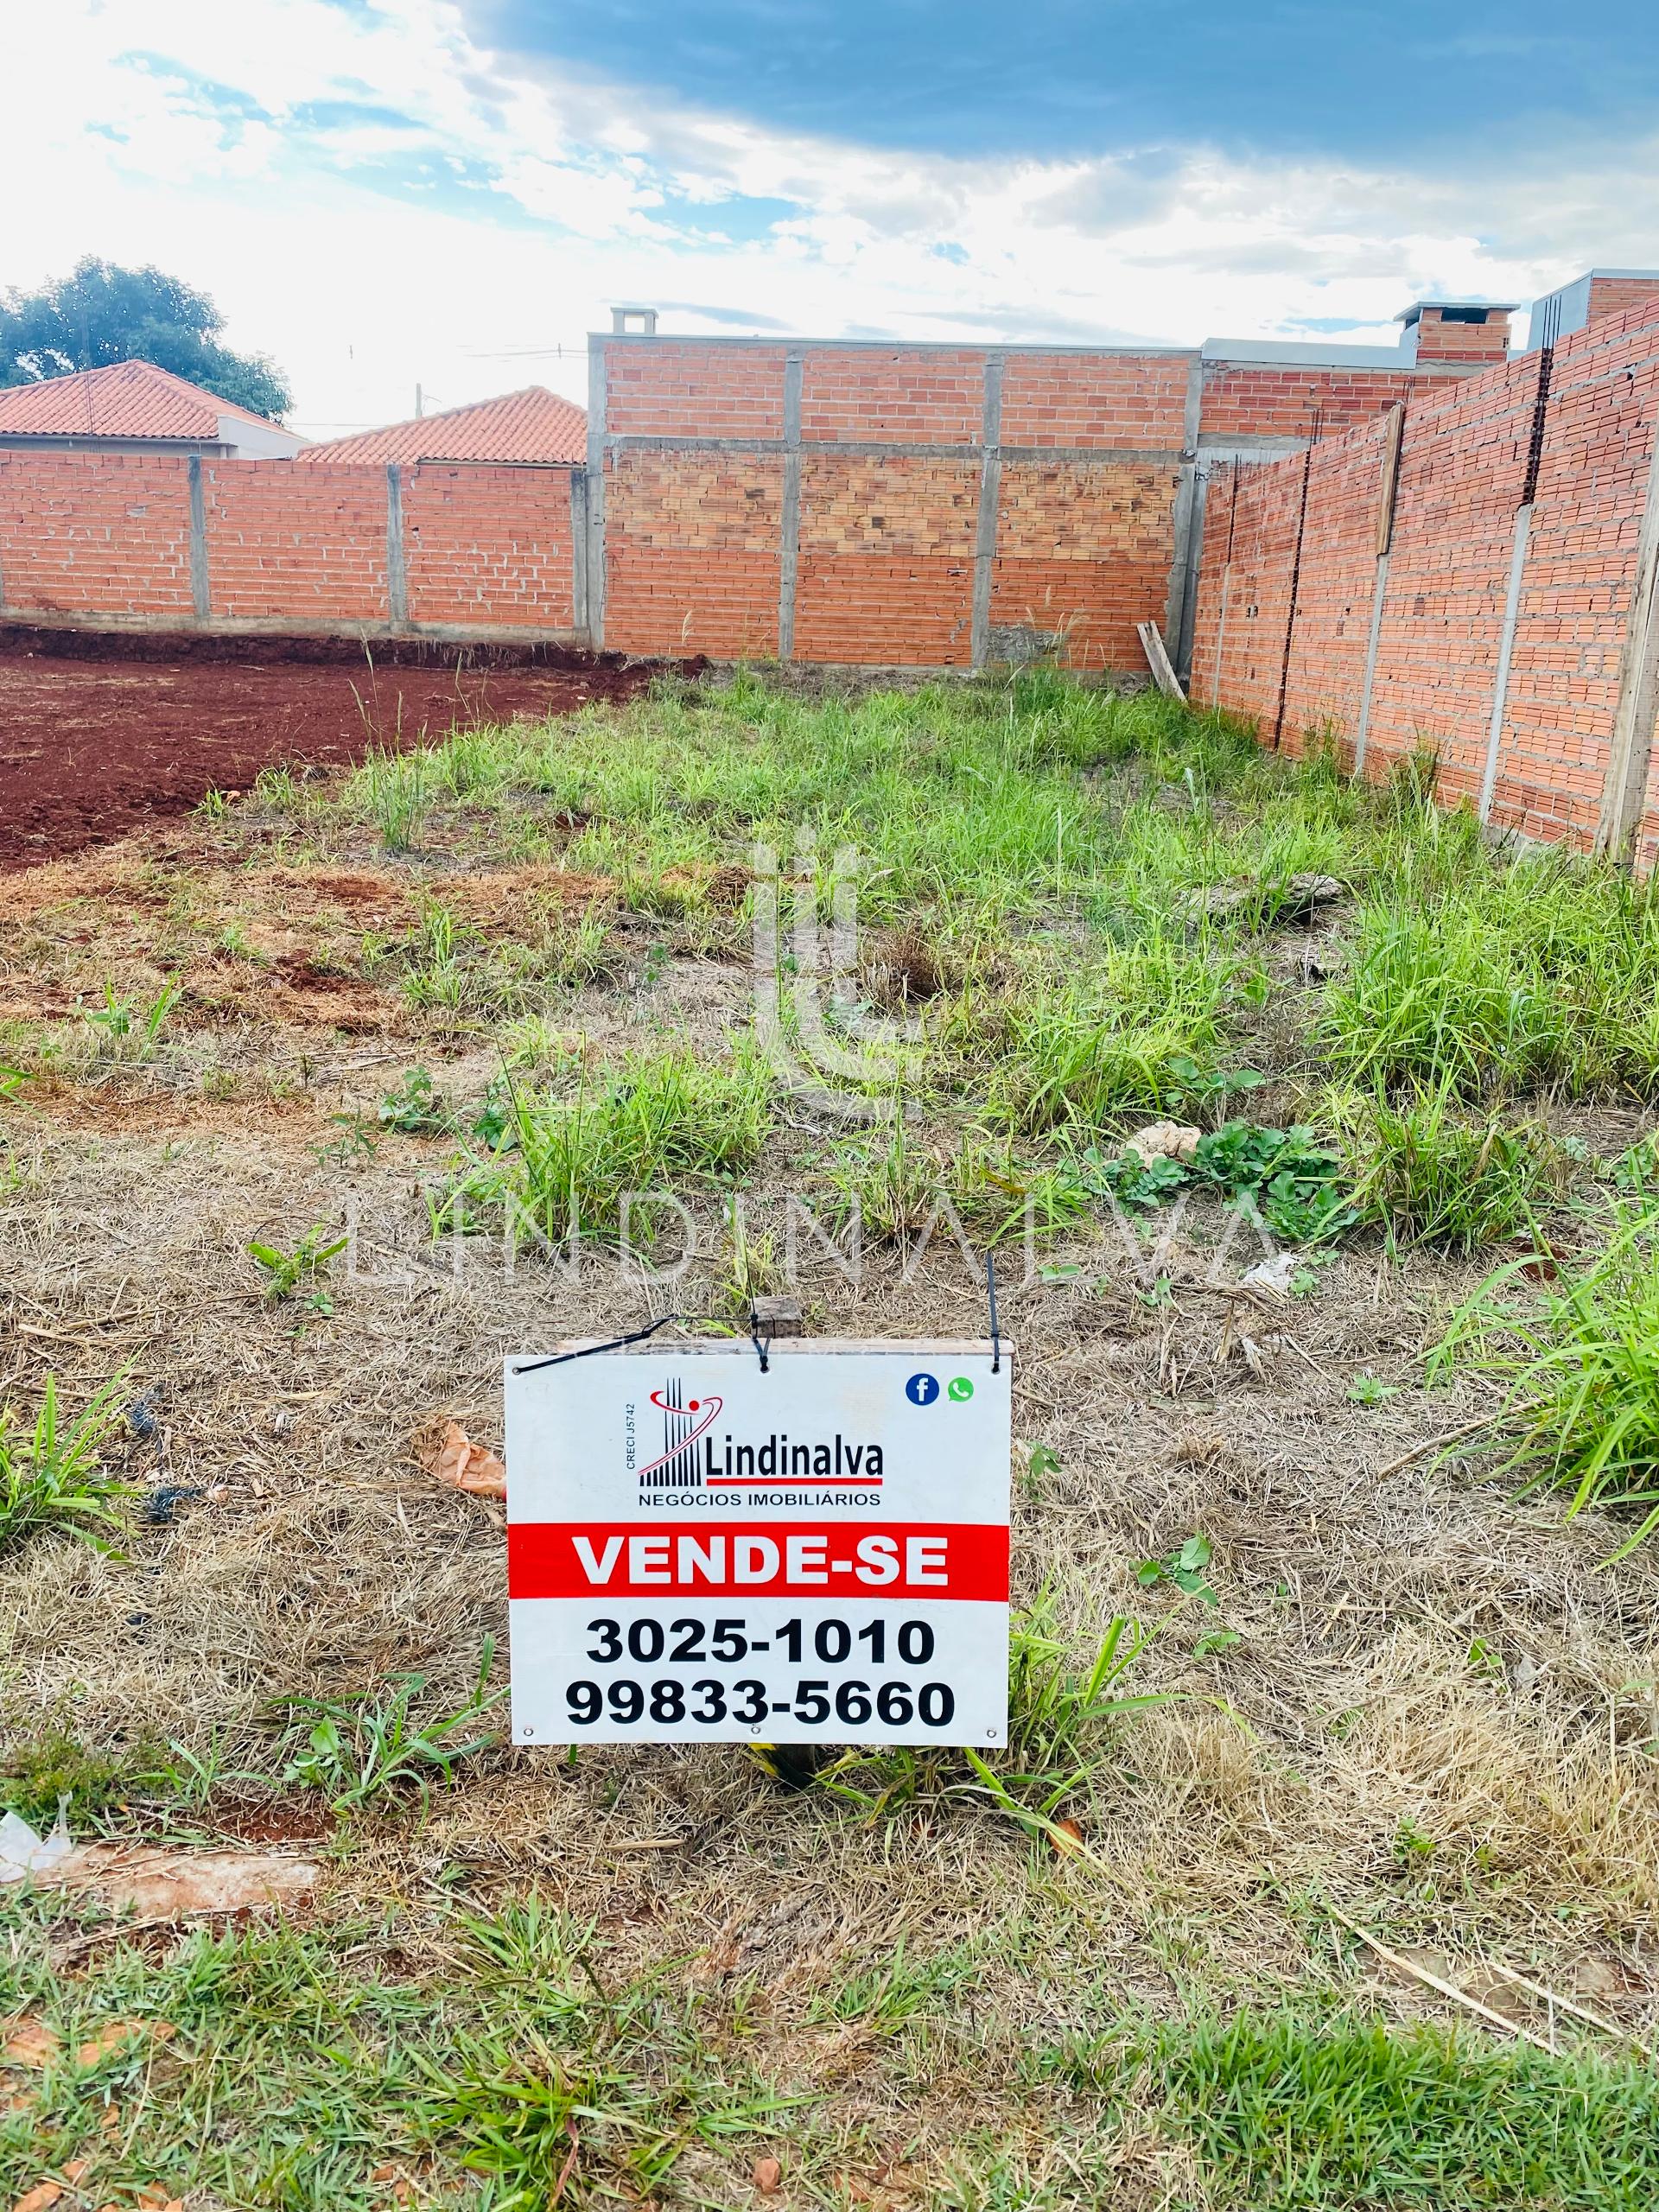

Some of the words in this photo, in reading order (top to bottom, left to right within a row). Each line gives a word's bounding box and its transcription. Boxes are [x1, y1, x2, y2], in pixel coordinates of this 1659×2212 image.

[626, 1403, 635, 1433] J5742
[626, 1437, 636, 1470] CRECI
[707, 1434, 882, 1475] Lindinalva
[639, 1491, 741, 1506] NEGÓCIOS
[749, 1491, 880, 1505] IMOBILIÁRIOS
[572, 1536, 948, 1586] VENDE-SE
[587, 1619, 934, 1664] 3025-1010
[566, 1680, 954, 1726] 99833-5660
